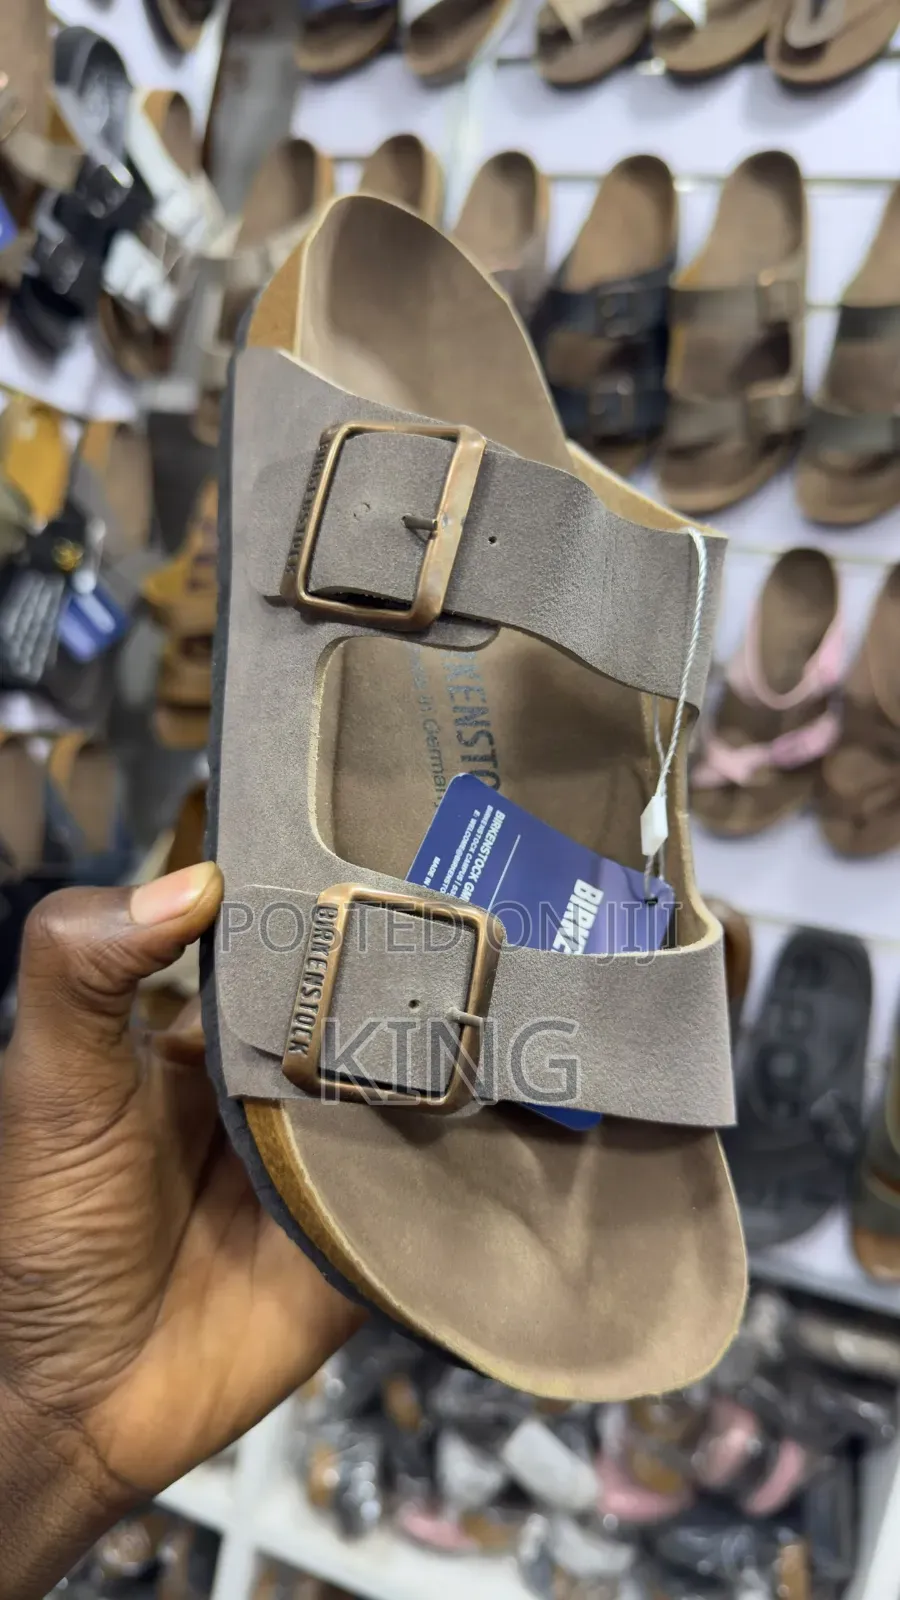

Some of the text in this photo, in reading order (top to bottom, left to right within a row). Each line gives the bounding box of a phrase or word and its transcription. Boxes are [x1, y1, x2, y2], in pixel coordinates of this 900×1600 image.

[469, 804, 493, 853] BIRKENSTOCK
[471, 809, 506, 883] BIRKENSTOCK
[427, 856, 441, 878] MADE
[456, 853, 473, 882] CAMPUS
[551, 879, 604, 955] BIRKE
[288, 903, 339, 1056] BIRKENSTOCK
